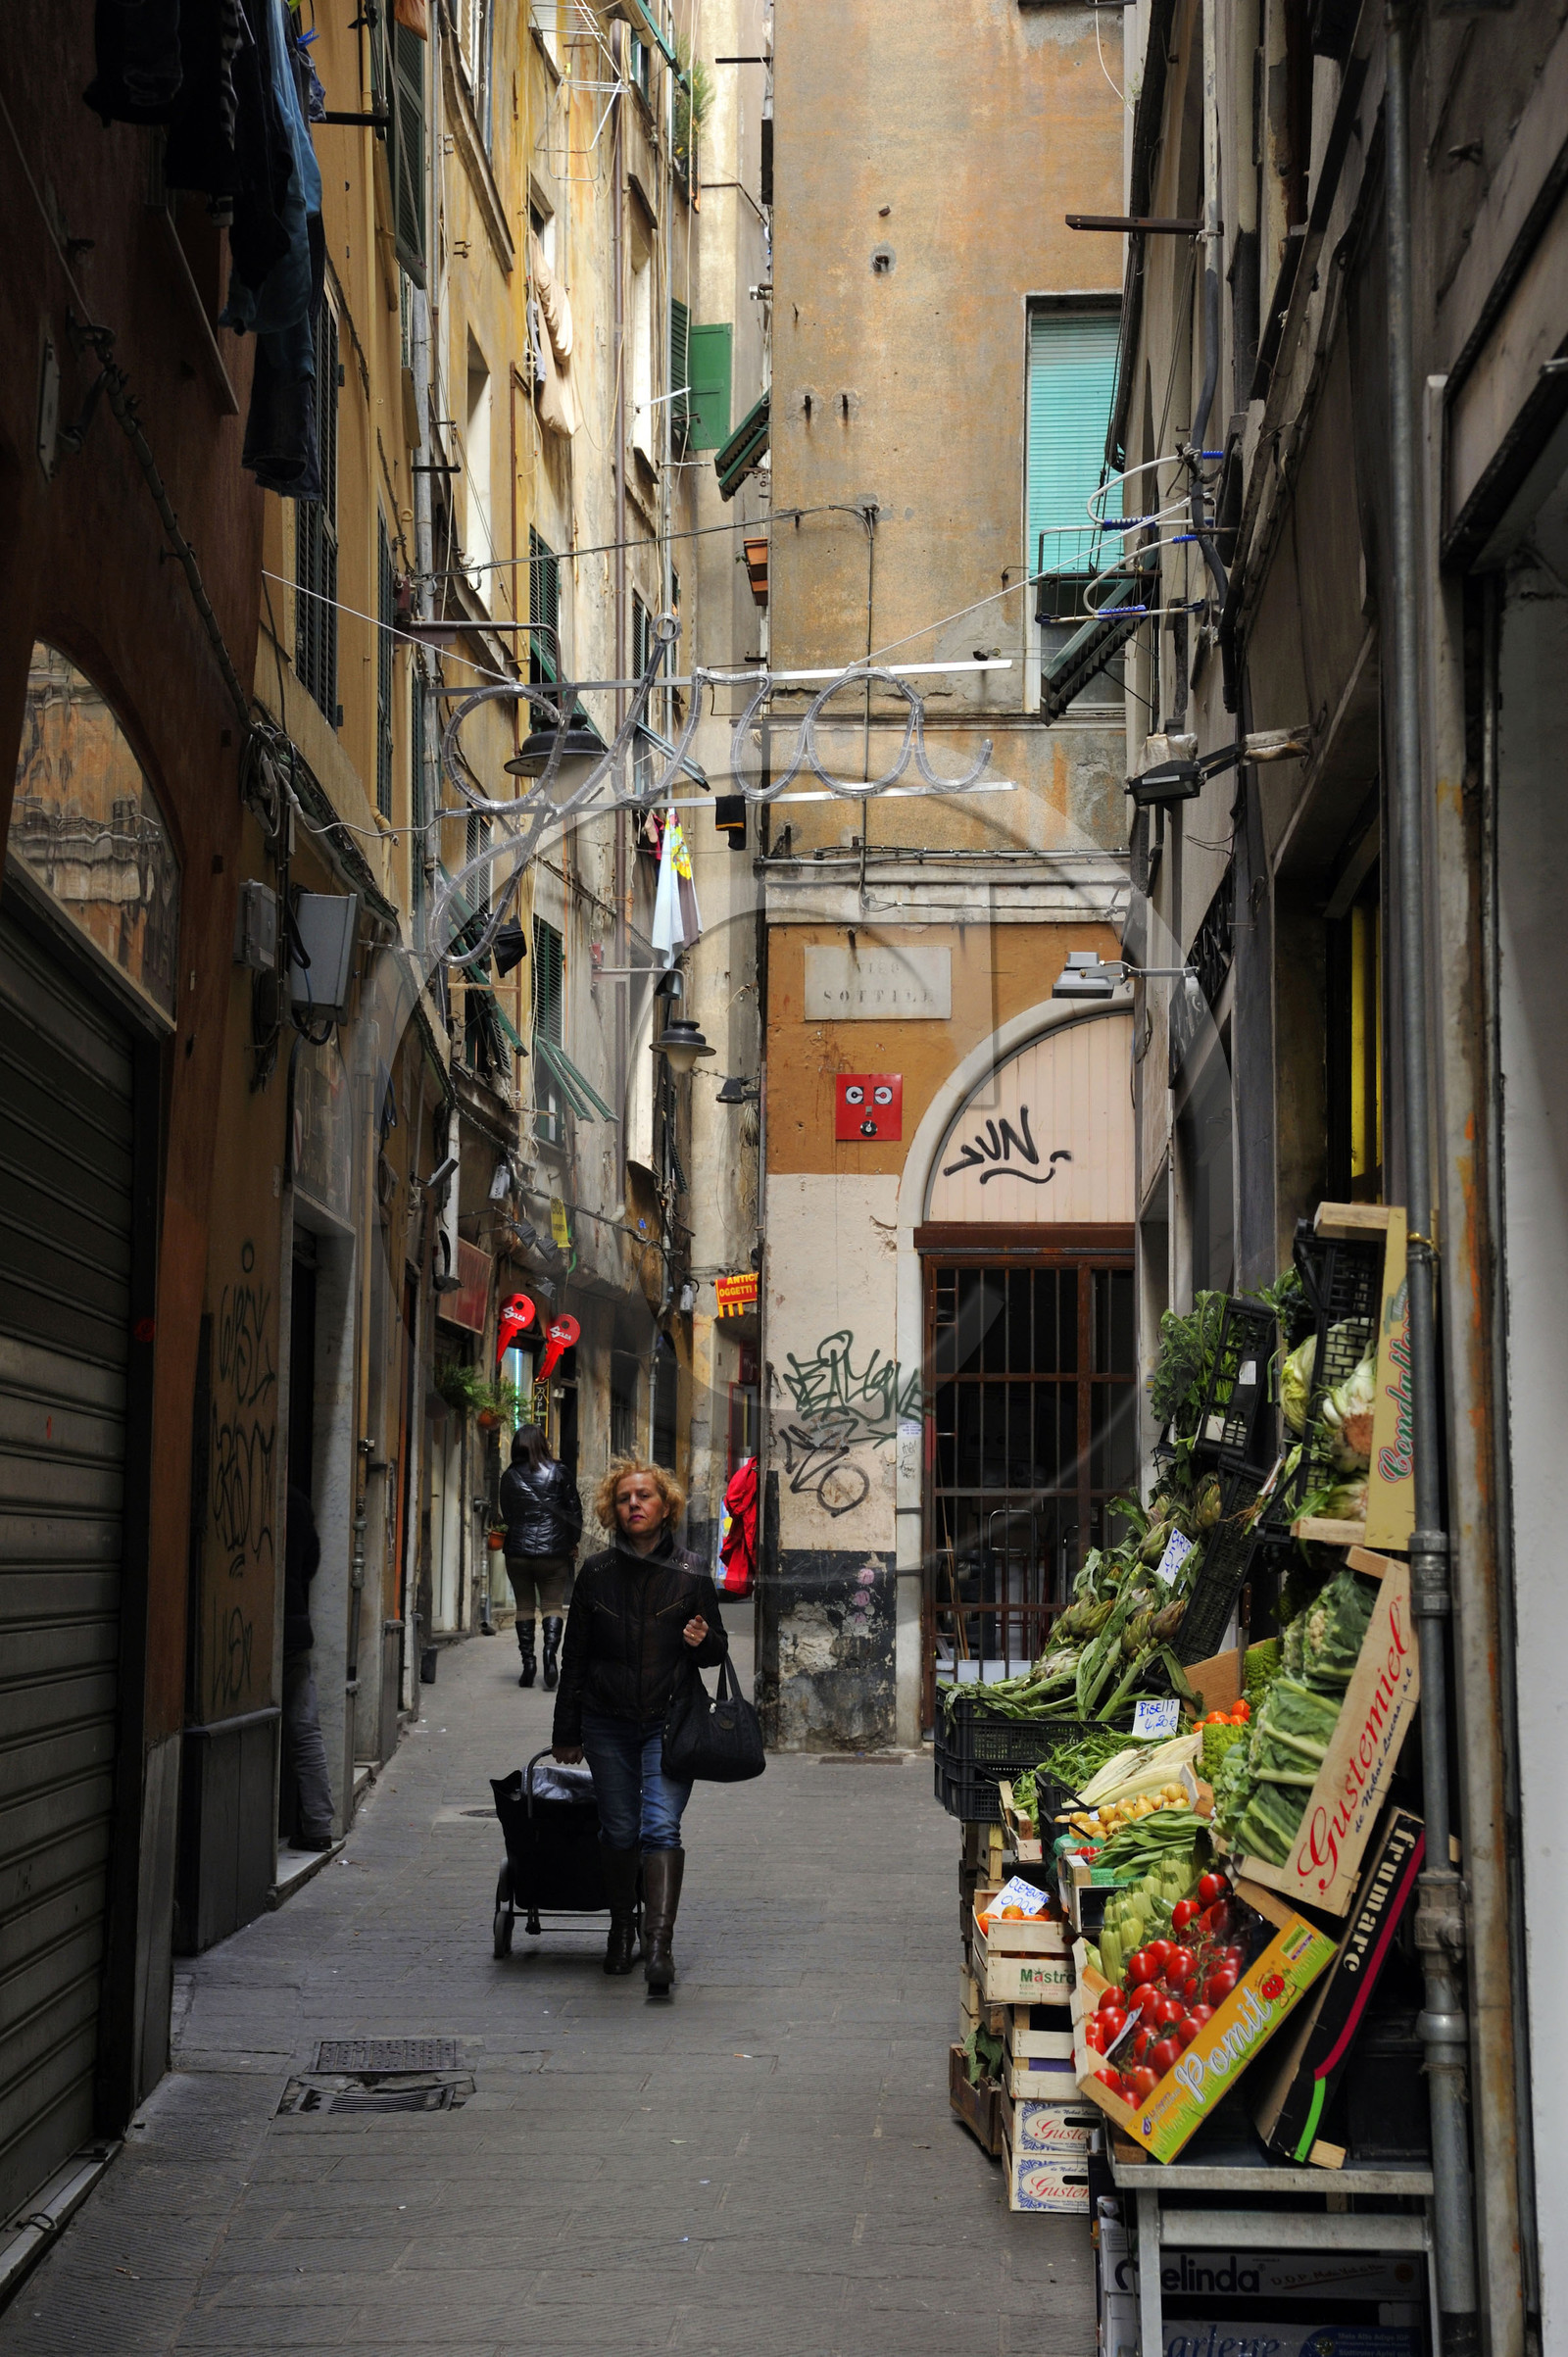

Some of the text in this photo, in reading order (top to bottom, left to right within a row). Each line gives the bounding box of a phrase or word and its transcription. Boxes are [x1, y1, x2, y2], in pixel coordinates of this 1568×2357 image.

[823, 988, 934, 1004] SOTTILE
[726, 1273, 758, 1286] ANTIC
[719, 1285, 753, 1298] OGGETTI
[1297, 1600, 1411, 1894] Gustemiel
[1036, 2118, 1087, 2140] Guste
